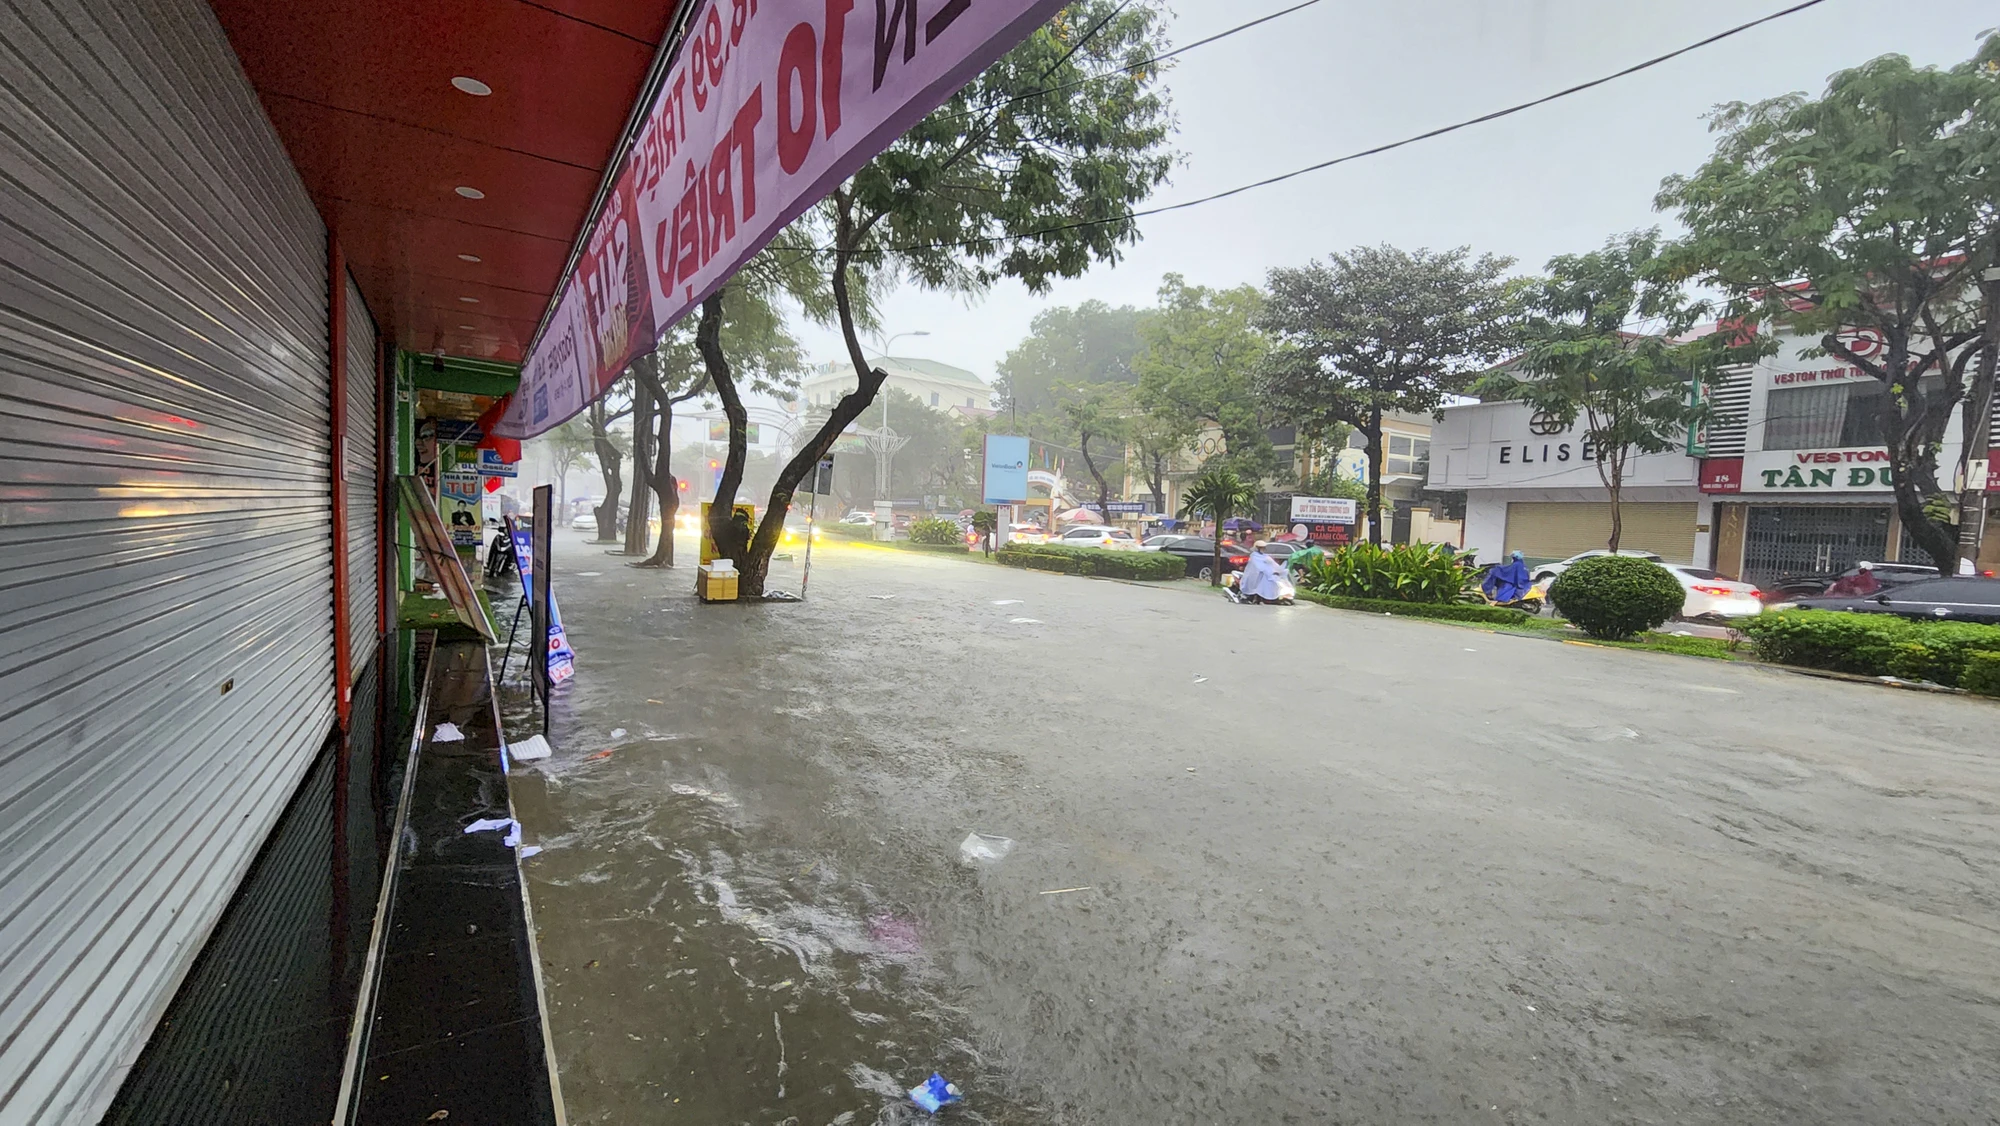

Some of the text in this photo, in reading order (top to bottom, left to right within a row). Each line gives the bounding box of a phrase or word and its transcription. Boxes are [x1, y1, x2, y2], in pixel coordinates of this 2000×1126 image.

[1774, 370, 1817, 385] VESTON
[1499, 442, 1597, 464] ELISE
[1796, 450, 1891, 464] VESTON
[1715, 474, 1730, 483] 18
[1761, 465, 1837, 488] TÂN
